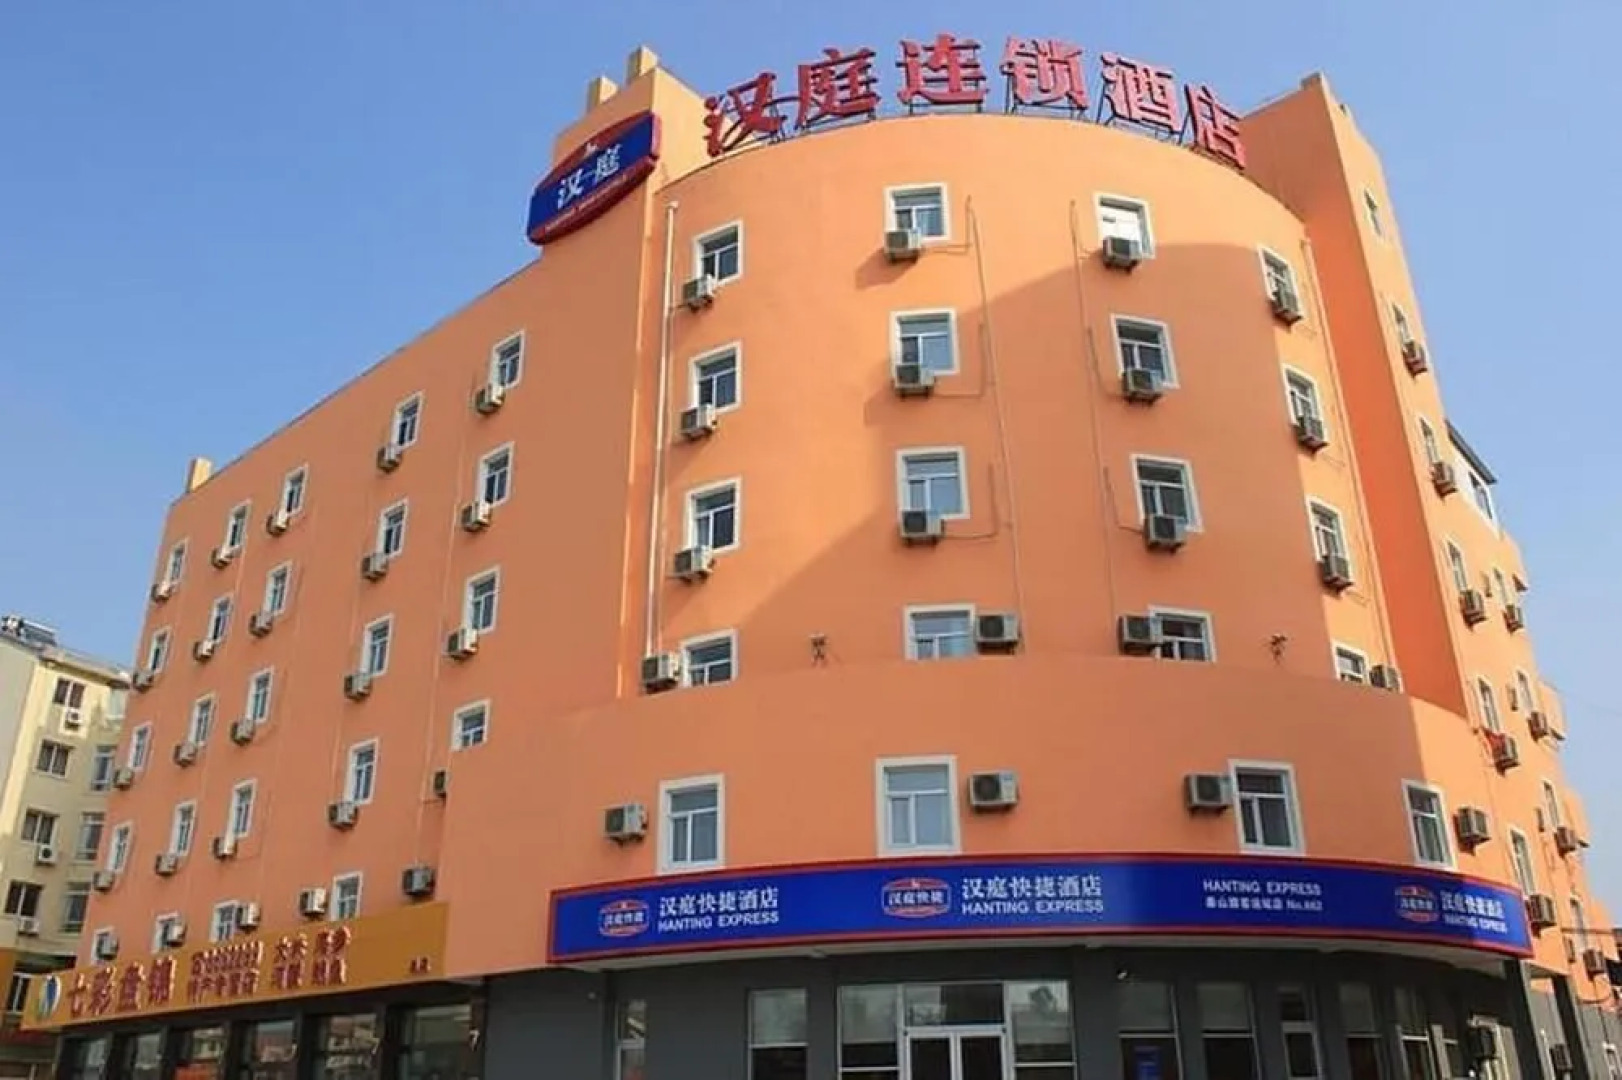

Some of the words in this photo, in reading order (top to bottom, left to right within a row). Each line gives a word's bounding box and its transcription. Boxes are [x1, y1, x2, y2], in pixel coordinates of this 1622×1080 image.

[703, 32, 1247, 169] 汉庭连锁酒店
[557, 143, 622, 210] 汉庭
[962, 874, 1102, 900] 汉庭快捷酒店
[1202, 879, 1261, 893] HANTING
[1266, 881, 1322, 896] EXPRESS
[659, 886, 779, 918] 汉庭快捷酒店
[962, 900, 1028, 916] HANTING
[1035, 899, 1104, 914] EXPRESS
[658, 915, 713, 933] HANTING
[717, 910, 780, 928] EXPRESS
